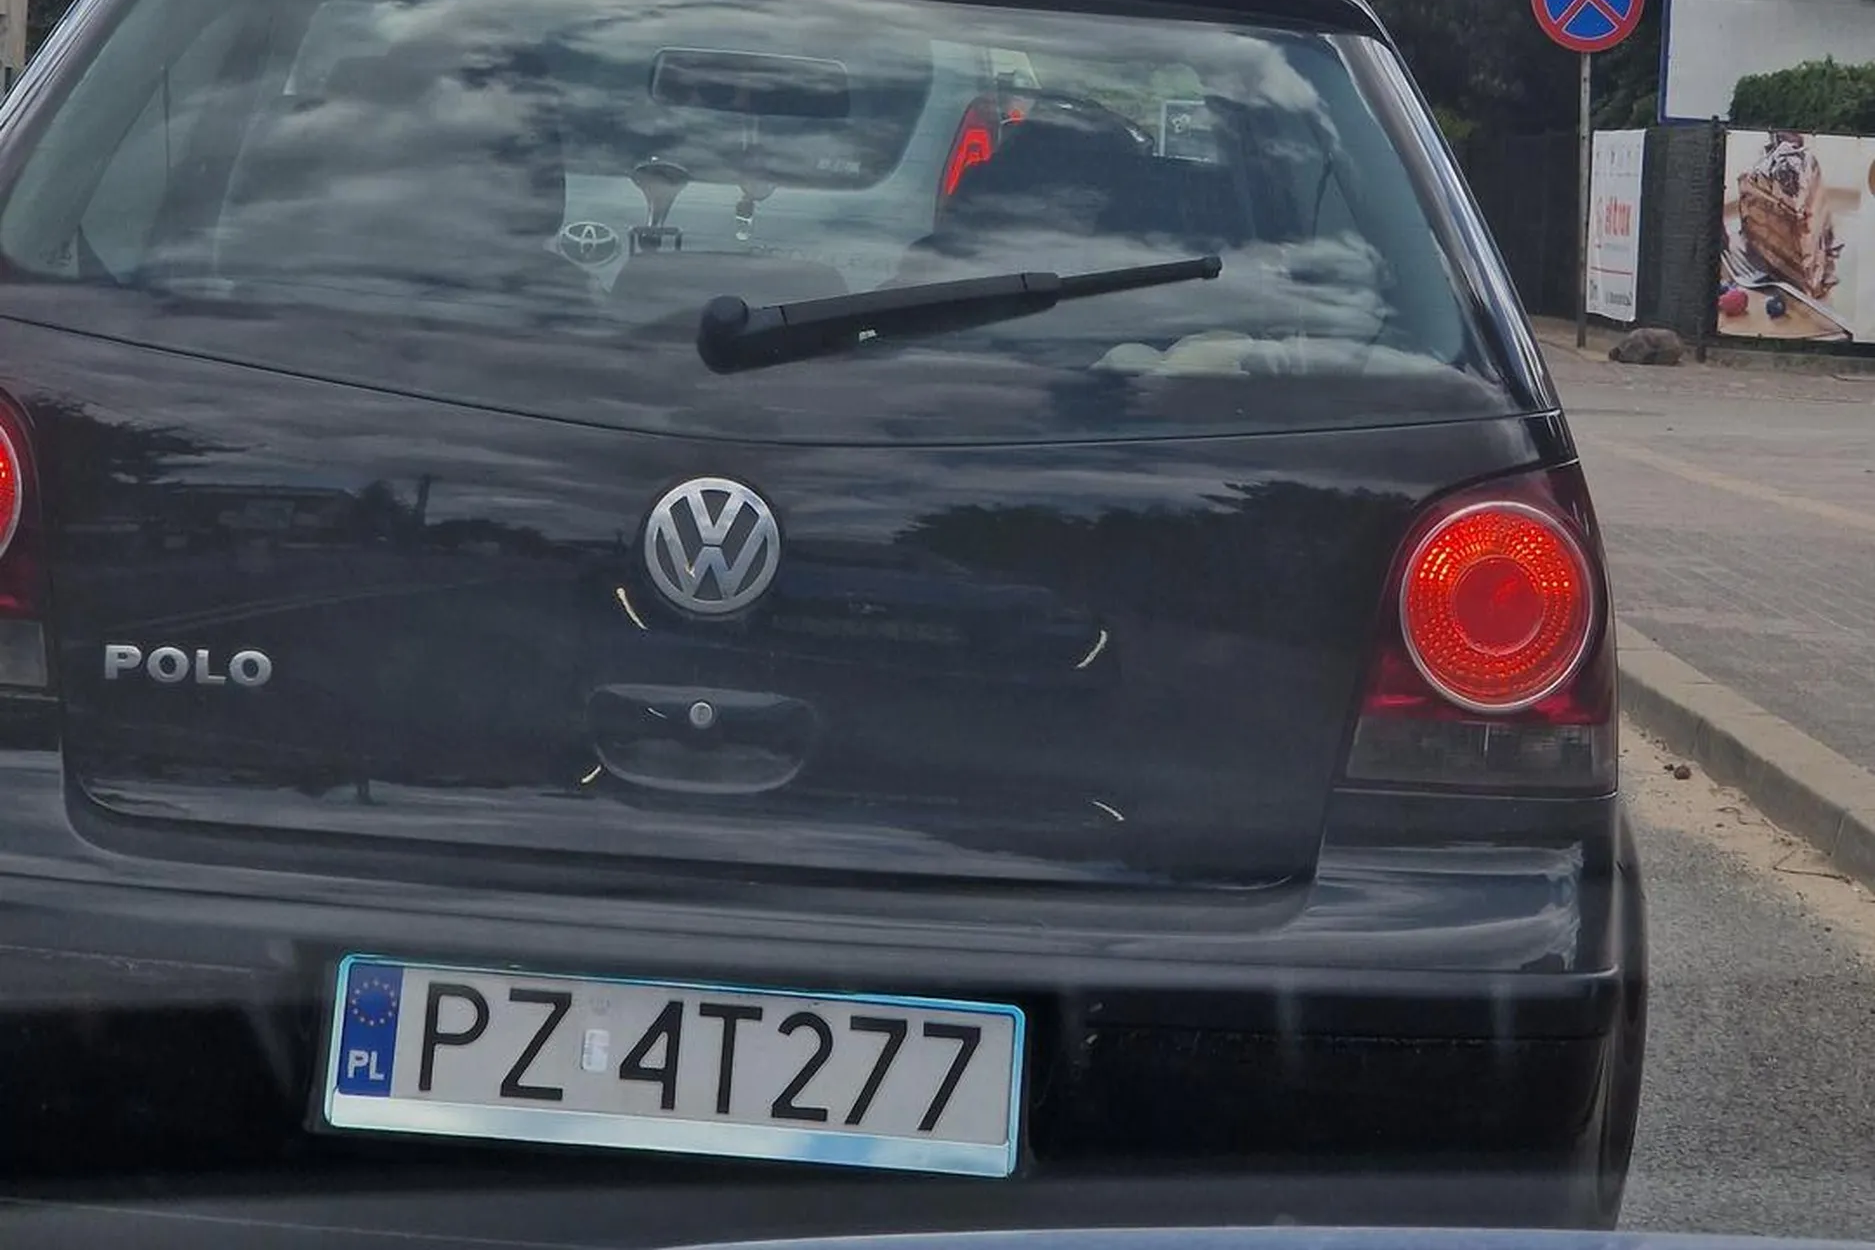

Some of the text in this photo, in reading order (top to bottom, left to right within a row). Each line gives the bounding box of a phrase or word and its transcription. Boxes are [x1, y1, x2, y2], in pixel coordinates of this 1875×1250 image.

[105, 644, 272, 686] POLO
[347, 1050, 385, 1081] PL
[419, 981, 982, 1132] PZ 4T277
